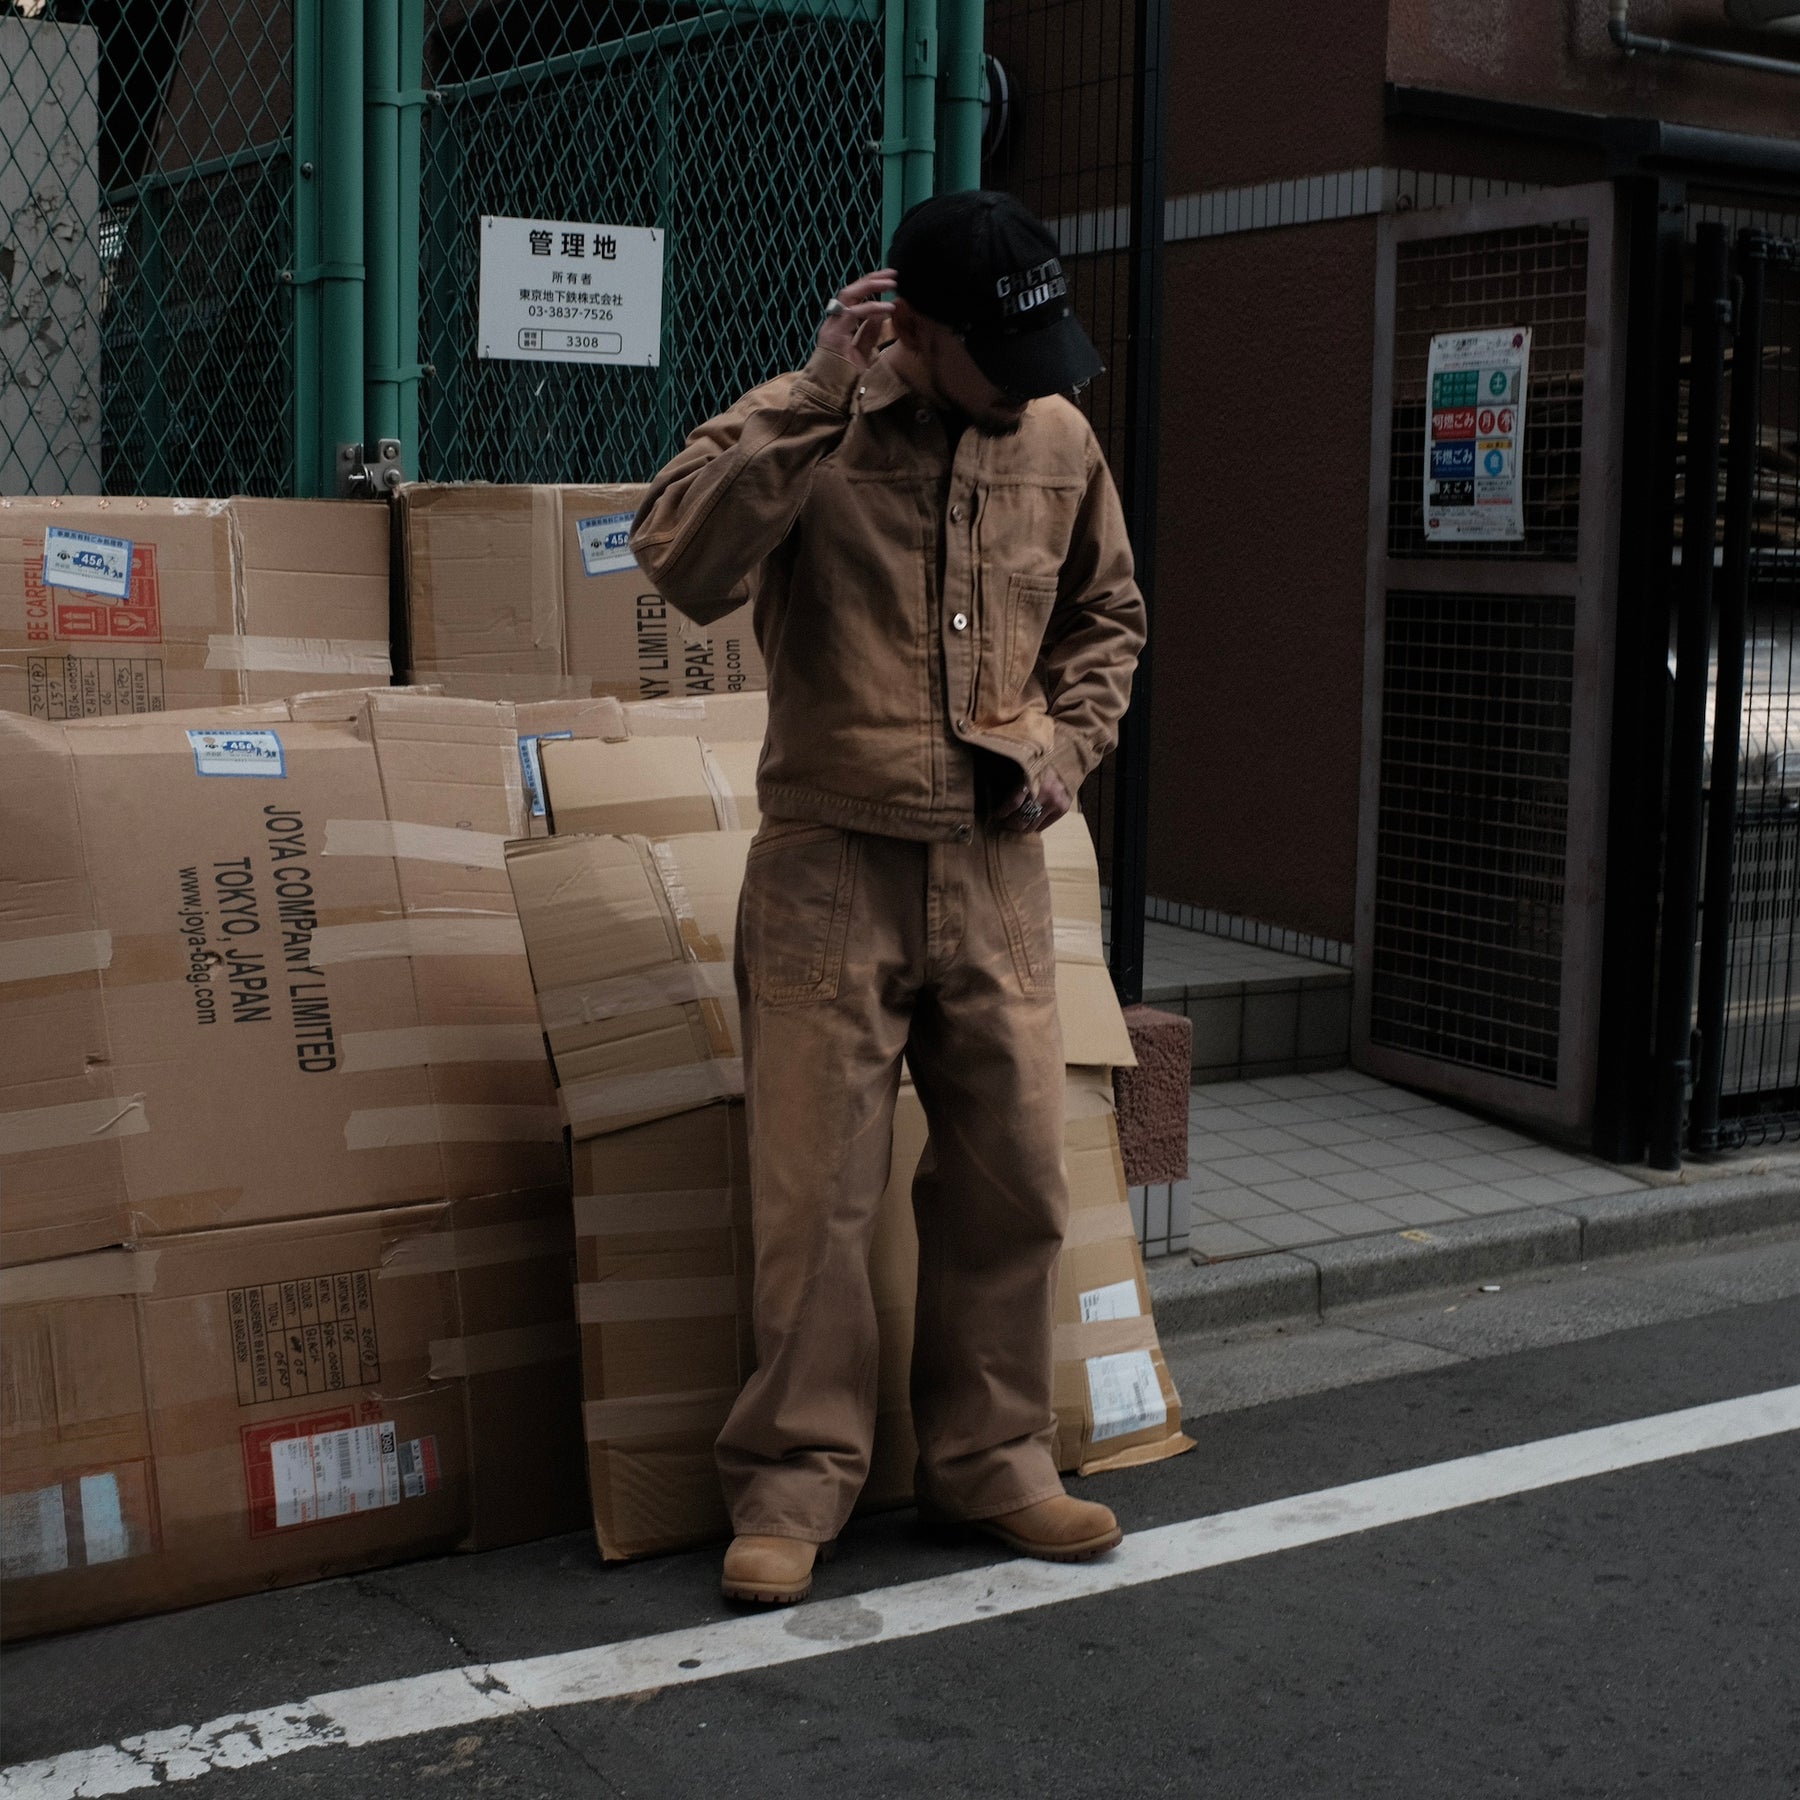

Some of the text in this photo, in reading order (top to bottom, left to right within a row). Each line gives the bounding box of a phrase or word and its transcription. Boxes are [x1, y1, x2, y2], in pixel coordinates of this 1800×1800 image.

[529, 229, 617, 261] 管理地
[552, 271, 593, 286] 所有者
[519, 288, 623, 306] 東京地下鉄株式会社
[528, 305, 614, 321] 03-3837-7526
[566, 336, 599, 348] 3308
[23, 554, 48, 618] CAREFUL
[27, 621, 49, 641] BE
[637, 594, 669, 669] LIMITED
[84, 670, 97, 714] CAMEL
[213, 856, 272, 1024] TOKYO, JAPAN
[263, 805, 337, 1074] JOYA COMPANY LIMITED
[305, 1327, 320, 1364] BLACK
[380, 1432, 394, 1453] 098
